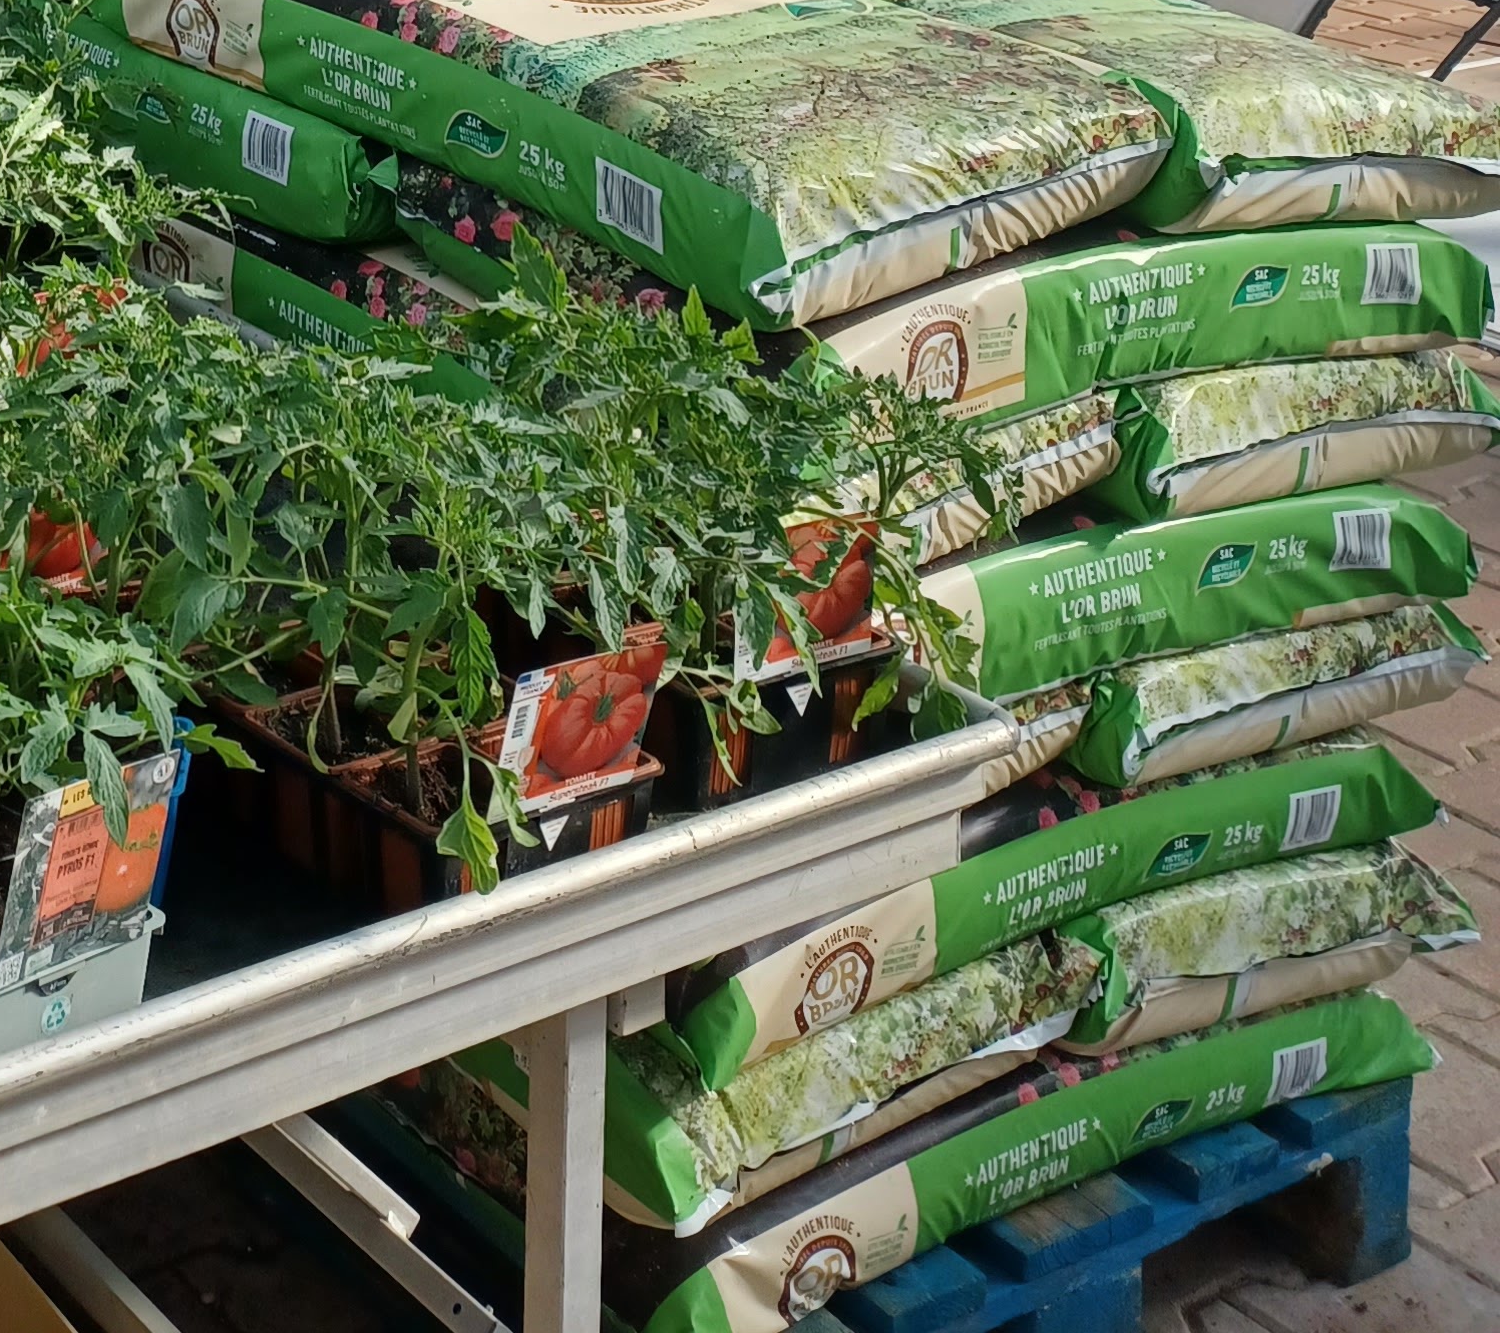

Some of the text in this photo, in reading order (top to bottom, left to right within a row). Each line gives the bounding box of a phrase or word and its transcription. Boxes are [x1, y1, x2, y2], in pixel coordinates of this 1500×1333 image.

[175, 4, 211, 37] OR
[179, 33, 209, 54] BRUN
[310, 37, 405, 90] AUTHENTIQUE
[322, 68, 391, 112] L'OR BRUN
[191, 102, 222, 136] 25 kg
[465, 115, 482, 130] SAC
[519, 141, 565, 181] 25 kg
[1089, 263, 1194, 305] AUTHENTIQUE
[1301, 262, 1340, 288] 25 kg
[902, 303, 969, 343] L'AUTHENTIQUE
[917, 337, 953, 378] OR
[1220, 547, 1234, 560] SAC
[1269, 534, 1308, 560] 25 kg
[1044, 548, 1153, 597] AUTHENTIQUE
[1062, 583, 1142, 624] L'OR BRUN
[839, 645, 848, 656] F1
[549, 779, 598, 803] Supersteak
[1174, 837, 1190, 851] SAC
[1223, 820, 1265, 847] 25 kg
[57, 856, 84, 880] PYROS
[996, 844, 1105, 905] AUTHENTIQUE
[1009, 895, 1042, 926] L'OR
[1045, 878, 1087, 910] BRUN
[805, 925, 873, 970] L'AUTHENTIQUE
[810, 955, 859, 1001] OR
[1206, 1082, 1246, 1111] 25 kg
[977, 1118, 1087, 1188] AUTHENTIQUE
[989, 1155, 1070, 1206] L'OR BRUN
[782, 1215, 855, 1267] L'AUTHENTIQUE
